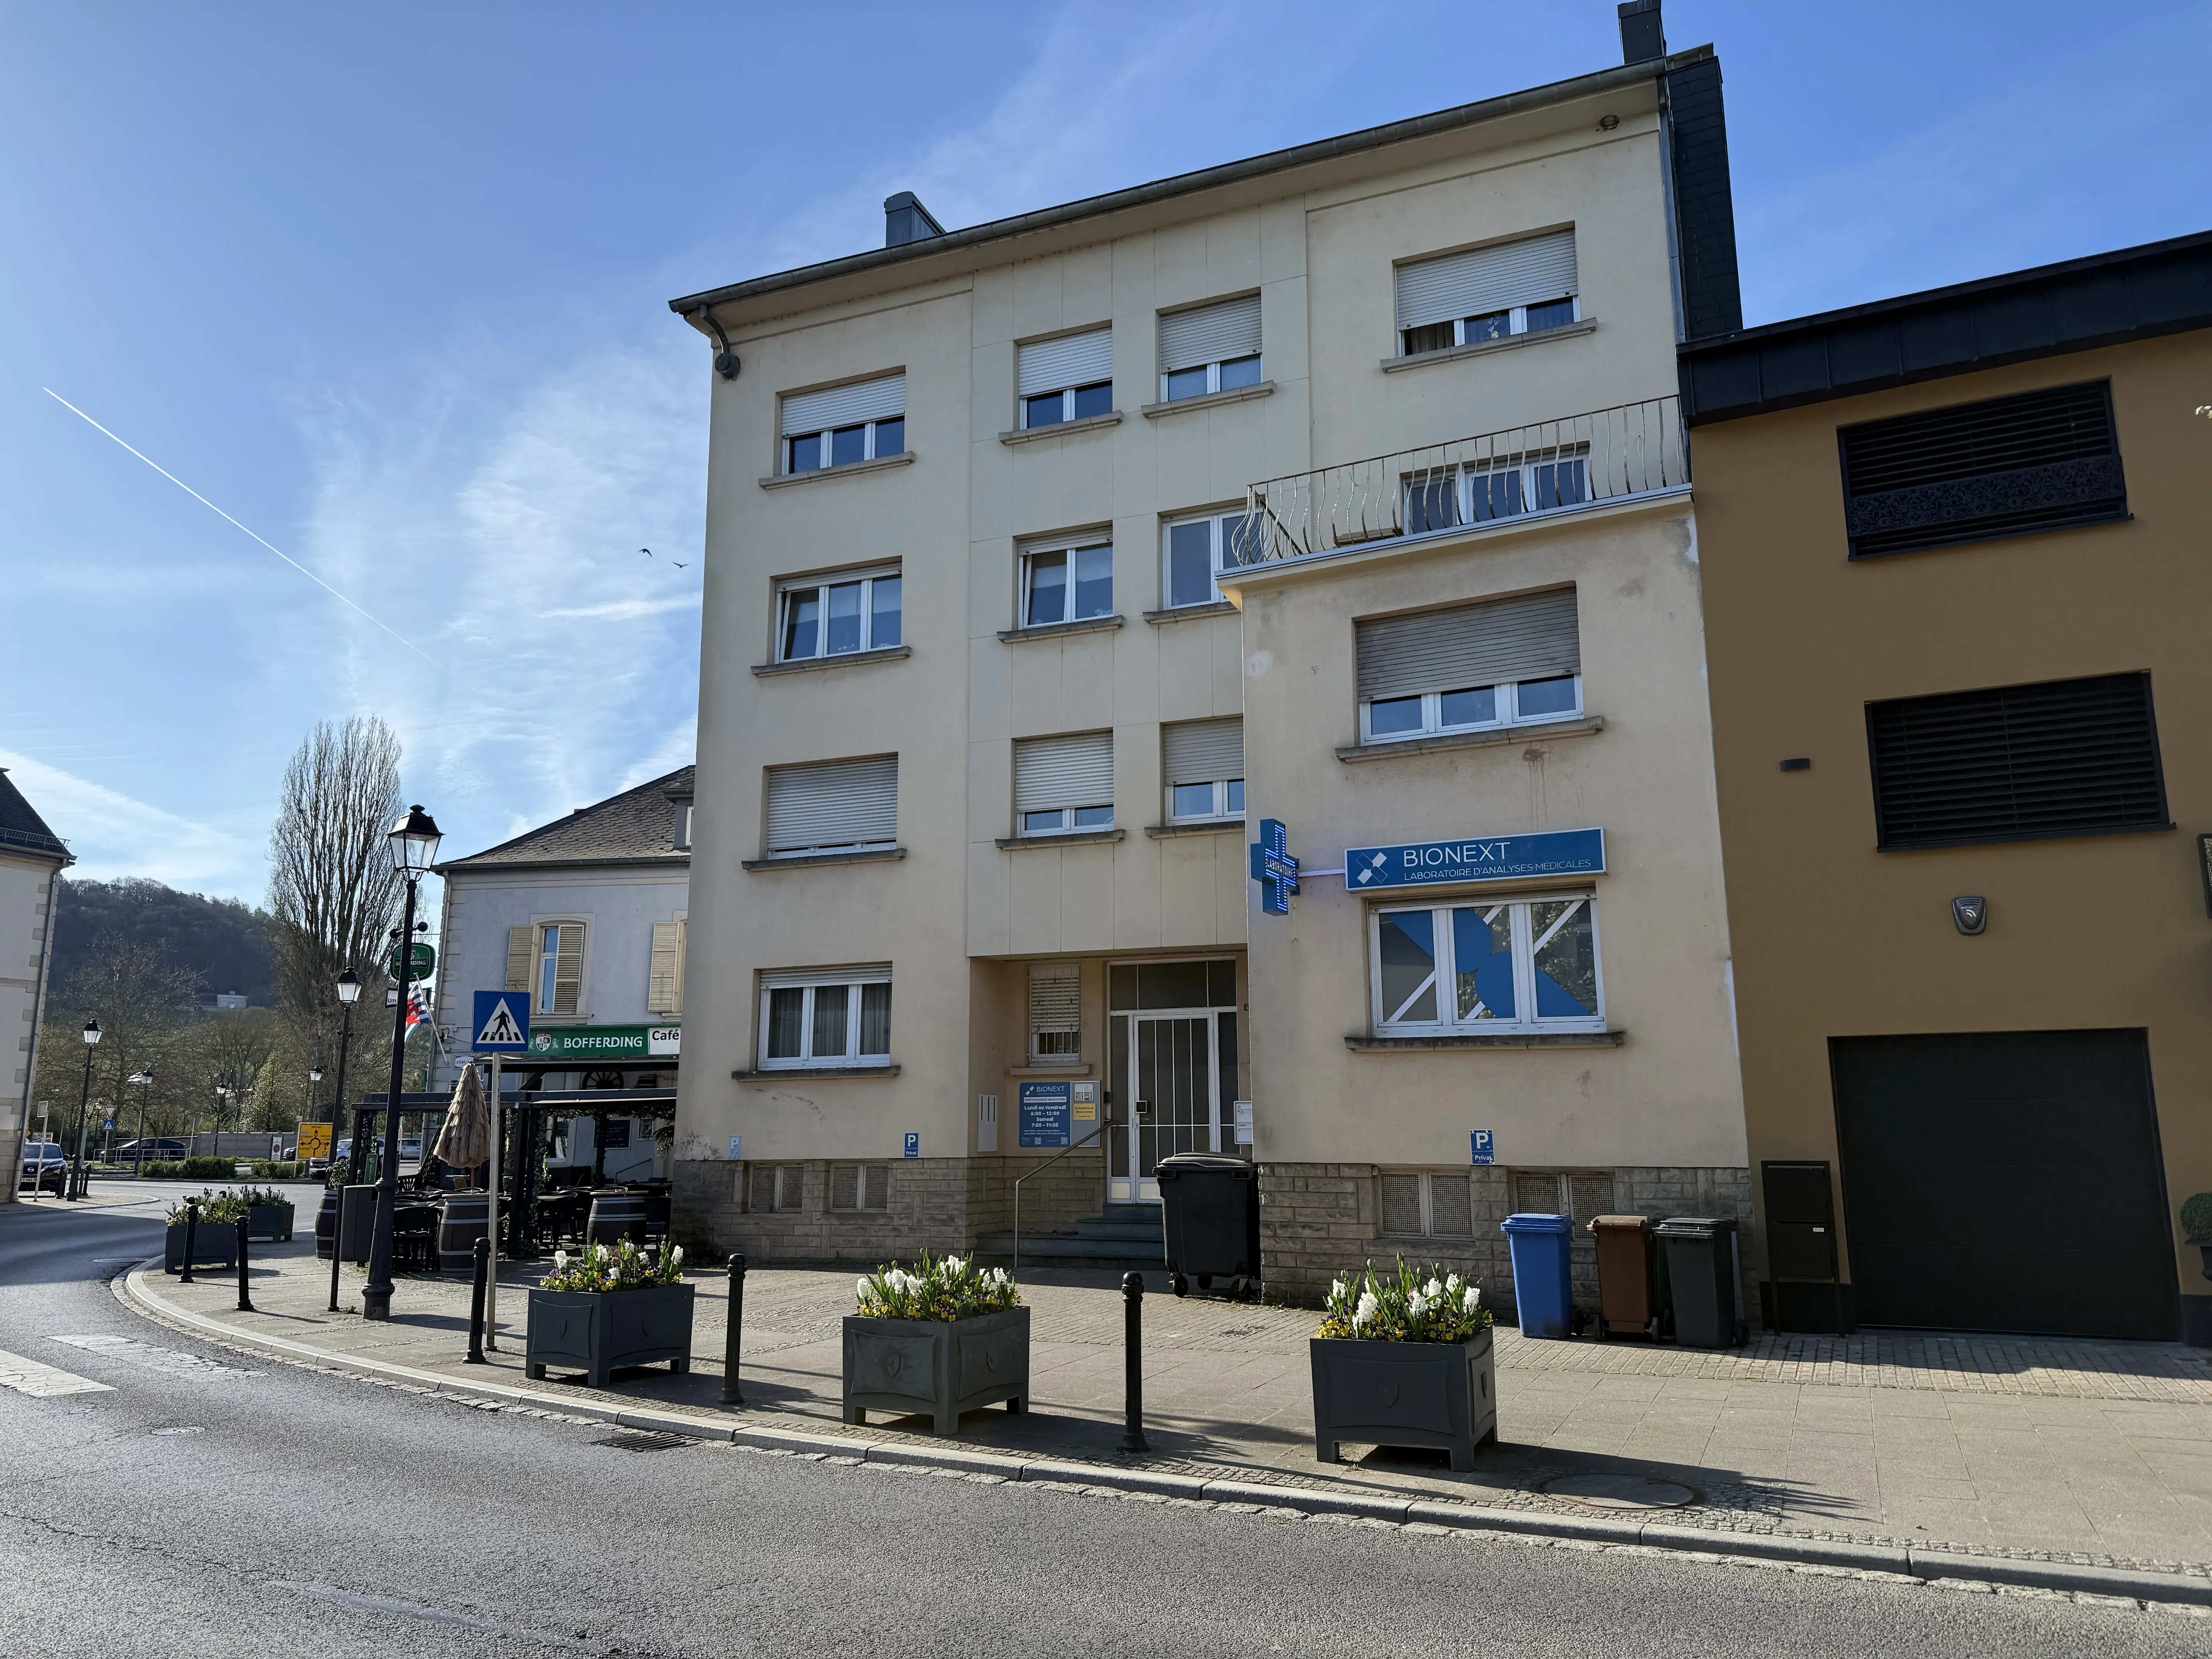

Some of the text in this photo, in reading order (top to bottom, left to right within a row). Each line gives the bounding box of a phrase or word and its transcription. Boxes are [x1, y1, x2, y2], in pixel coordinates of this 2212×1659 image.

[1403, 842, 1510, 867] BIONEXT
[1266, 858, 1293, 878] LABORATOIRE
[1404, 859, 1591, 880] LABORATOIRE D'ANALYSES MÉDICALES
[564, 1036, 643, 1048] BOFFERDING
[652, 1029, 679, 1041] Café
[731, 1138, 738, 1149] P
[908, 1135, 916, 1147] P
[1476, 1132, 1489, 1149] P
